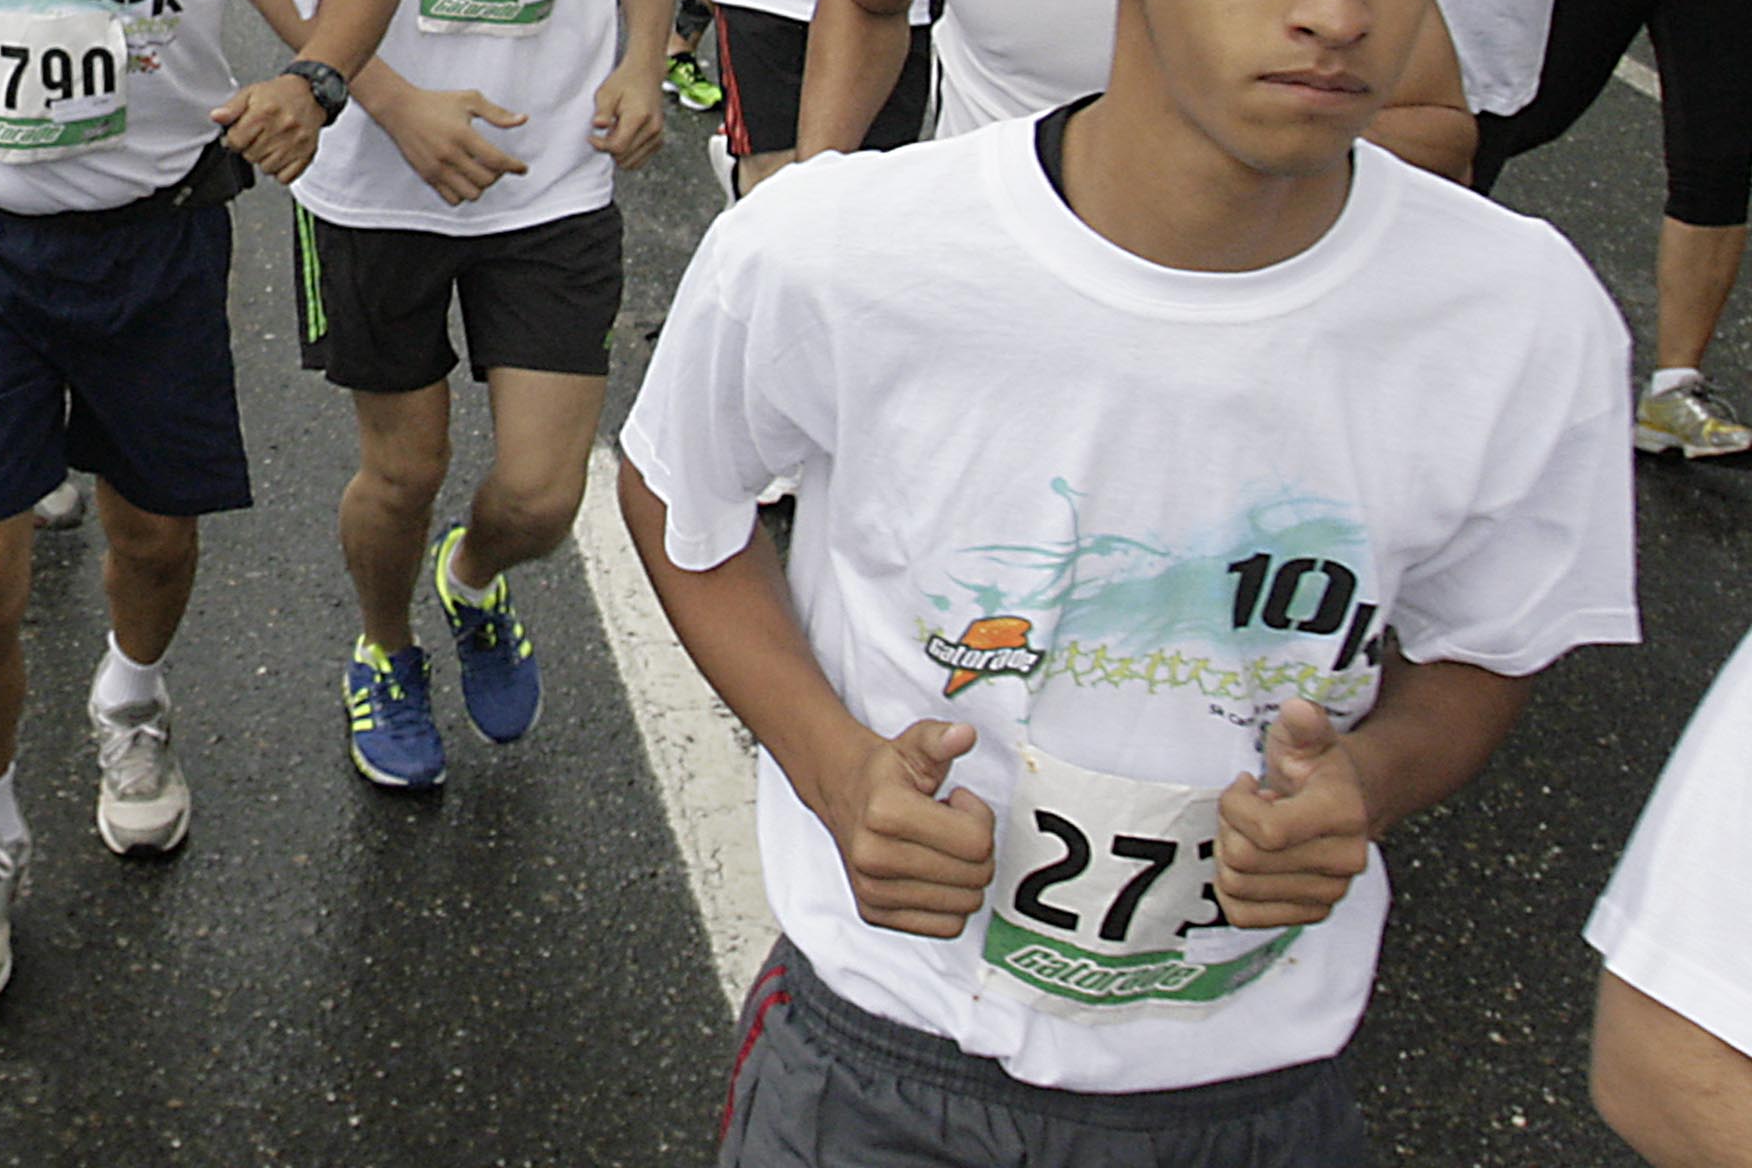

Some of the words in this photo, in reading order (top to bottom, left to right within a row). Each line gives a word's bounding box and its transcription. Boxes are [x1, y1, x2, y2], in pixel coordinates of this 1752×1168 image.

[1226, 552, 1385, 672] 10k
[927, 635, 1042, 675] Gatorade
[1007, 946, 1203, 995] Gatorade
